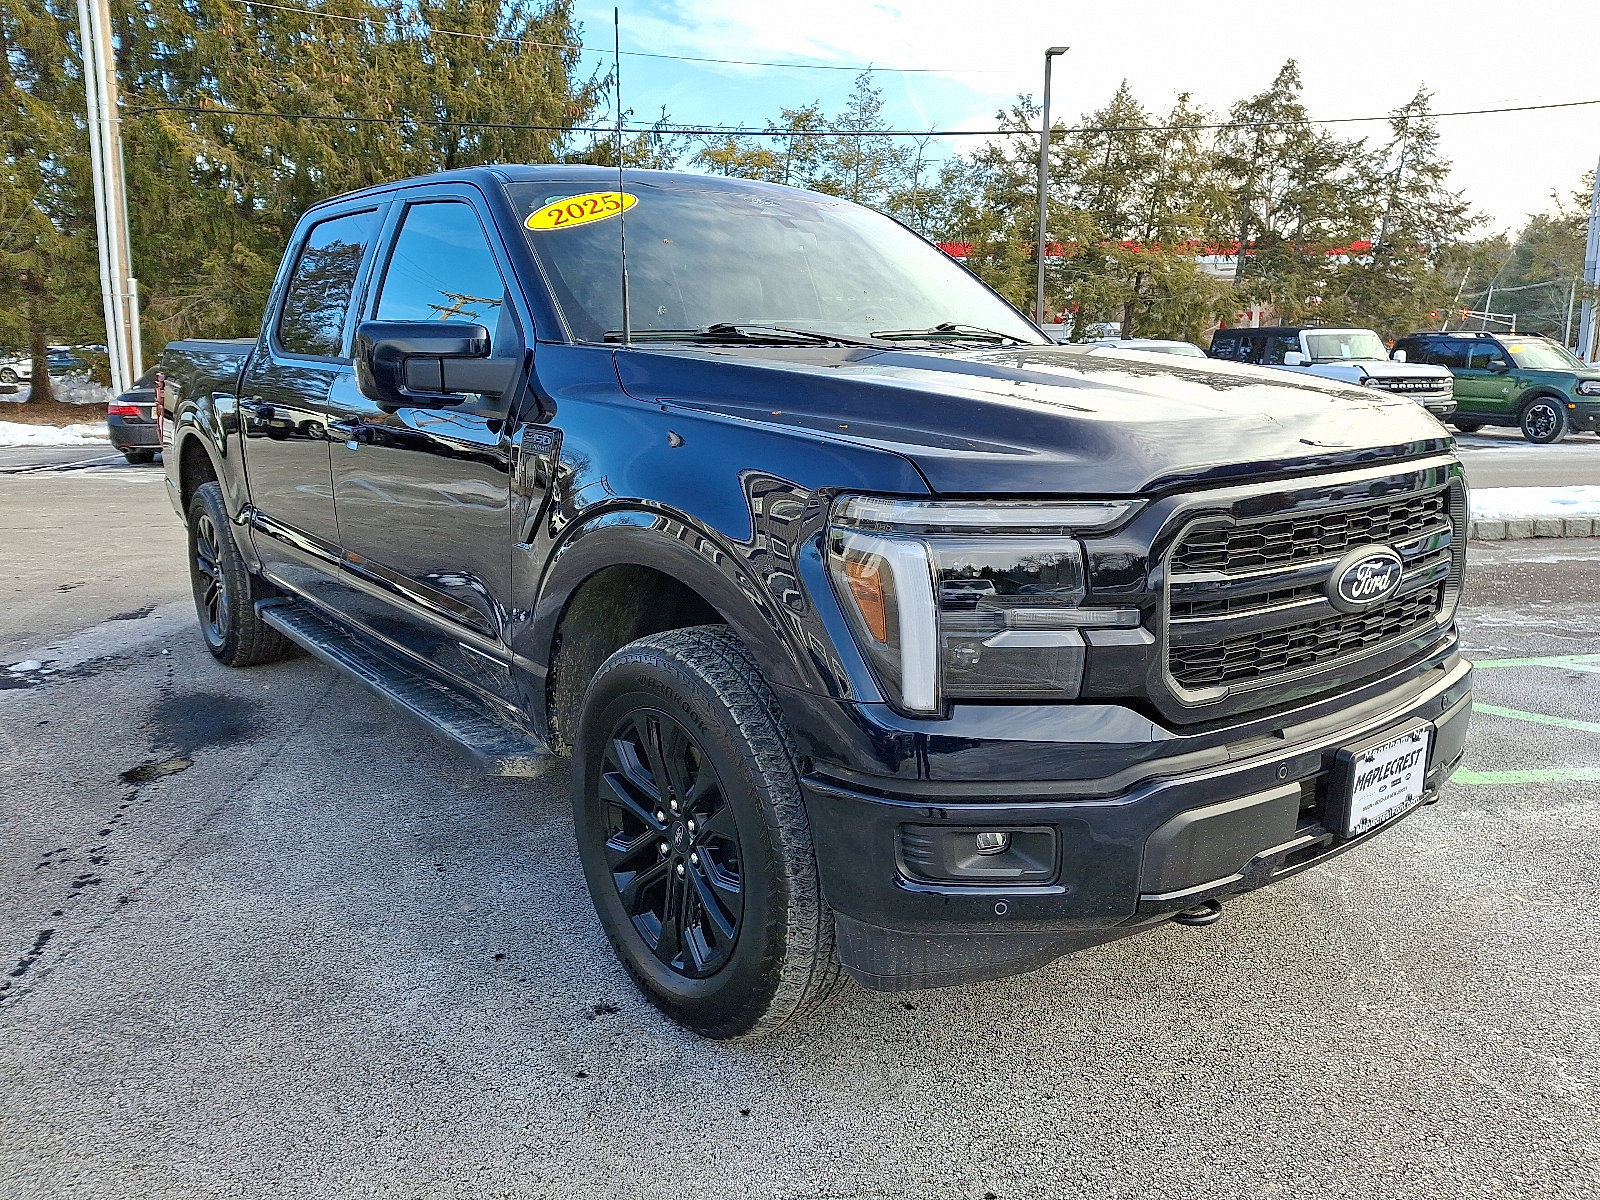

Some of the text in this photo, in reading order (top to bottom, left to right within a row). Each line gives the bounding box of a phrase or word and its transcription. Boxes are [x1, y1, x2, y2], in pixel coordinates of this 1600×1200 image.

[548, 195, 620, 225] 2025
[1352, 561, 1391, 597] Ford
[1354, 747, 1423, 794] MAPLECREST
